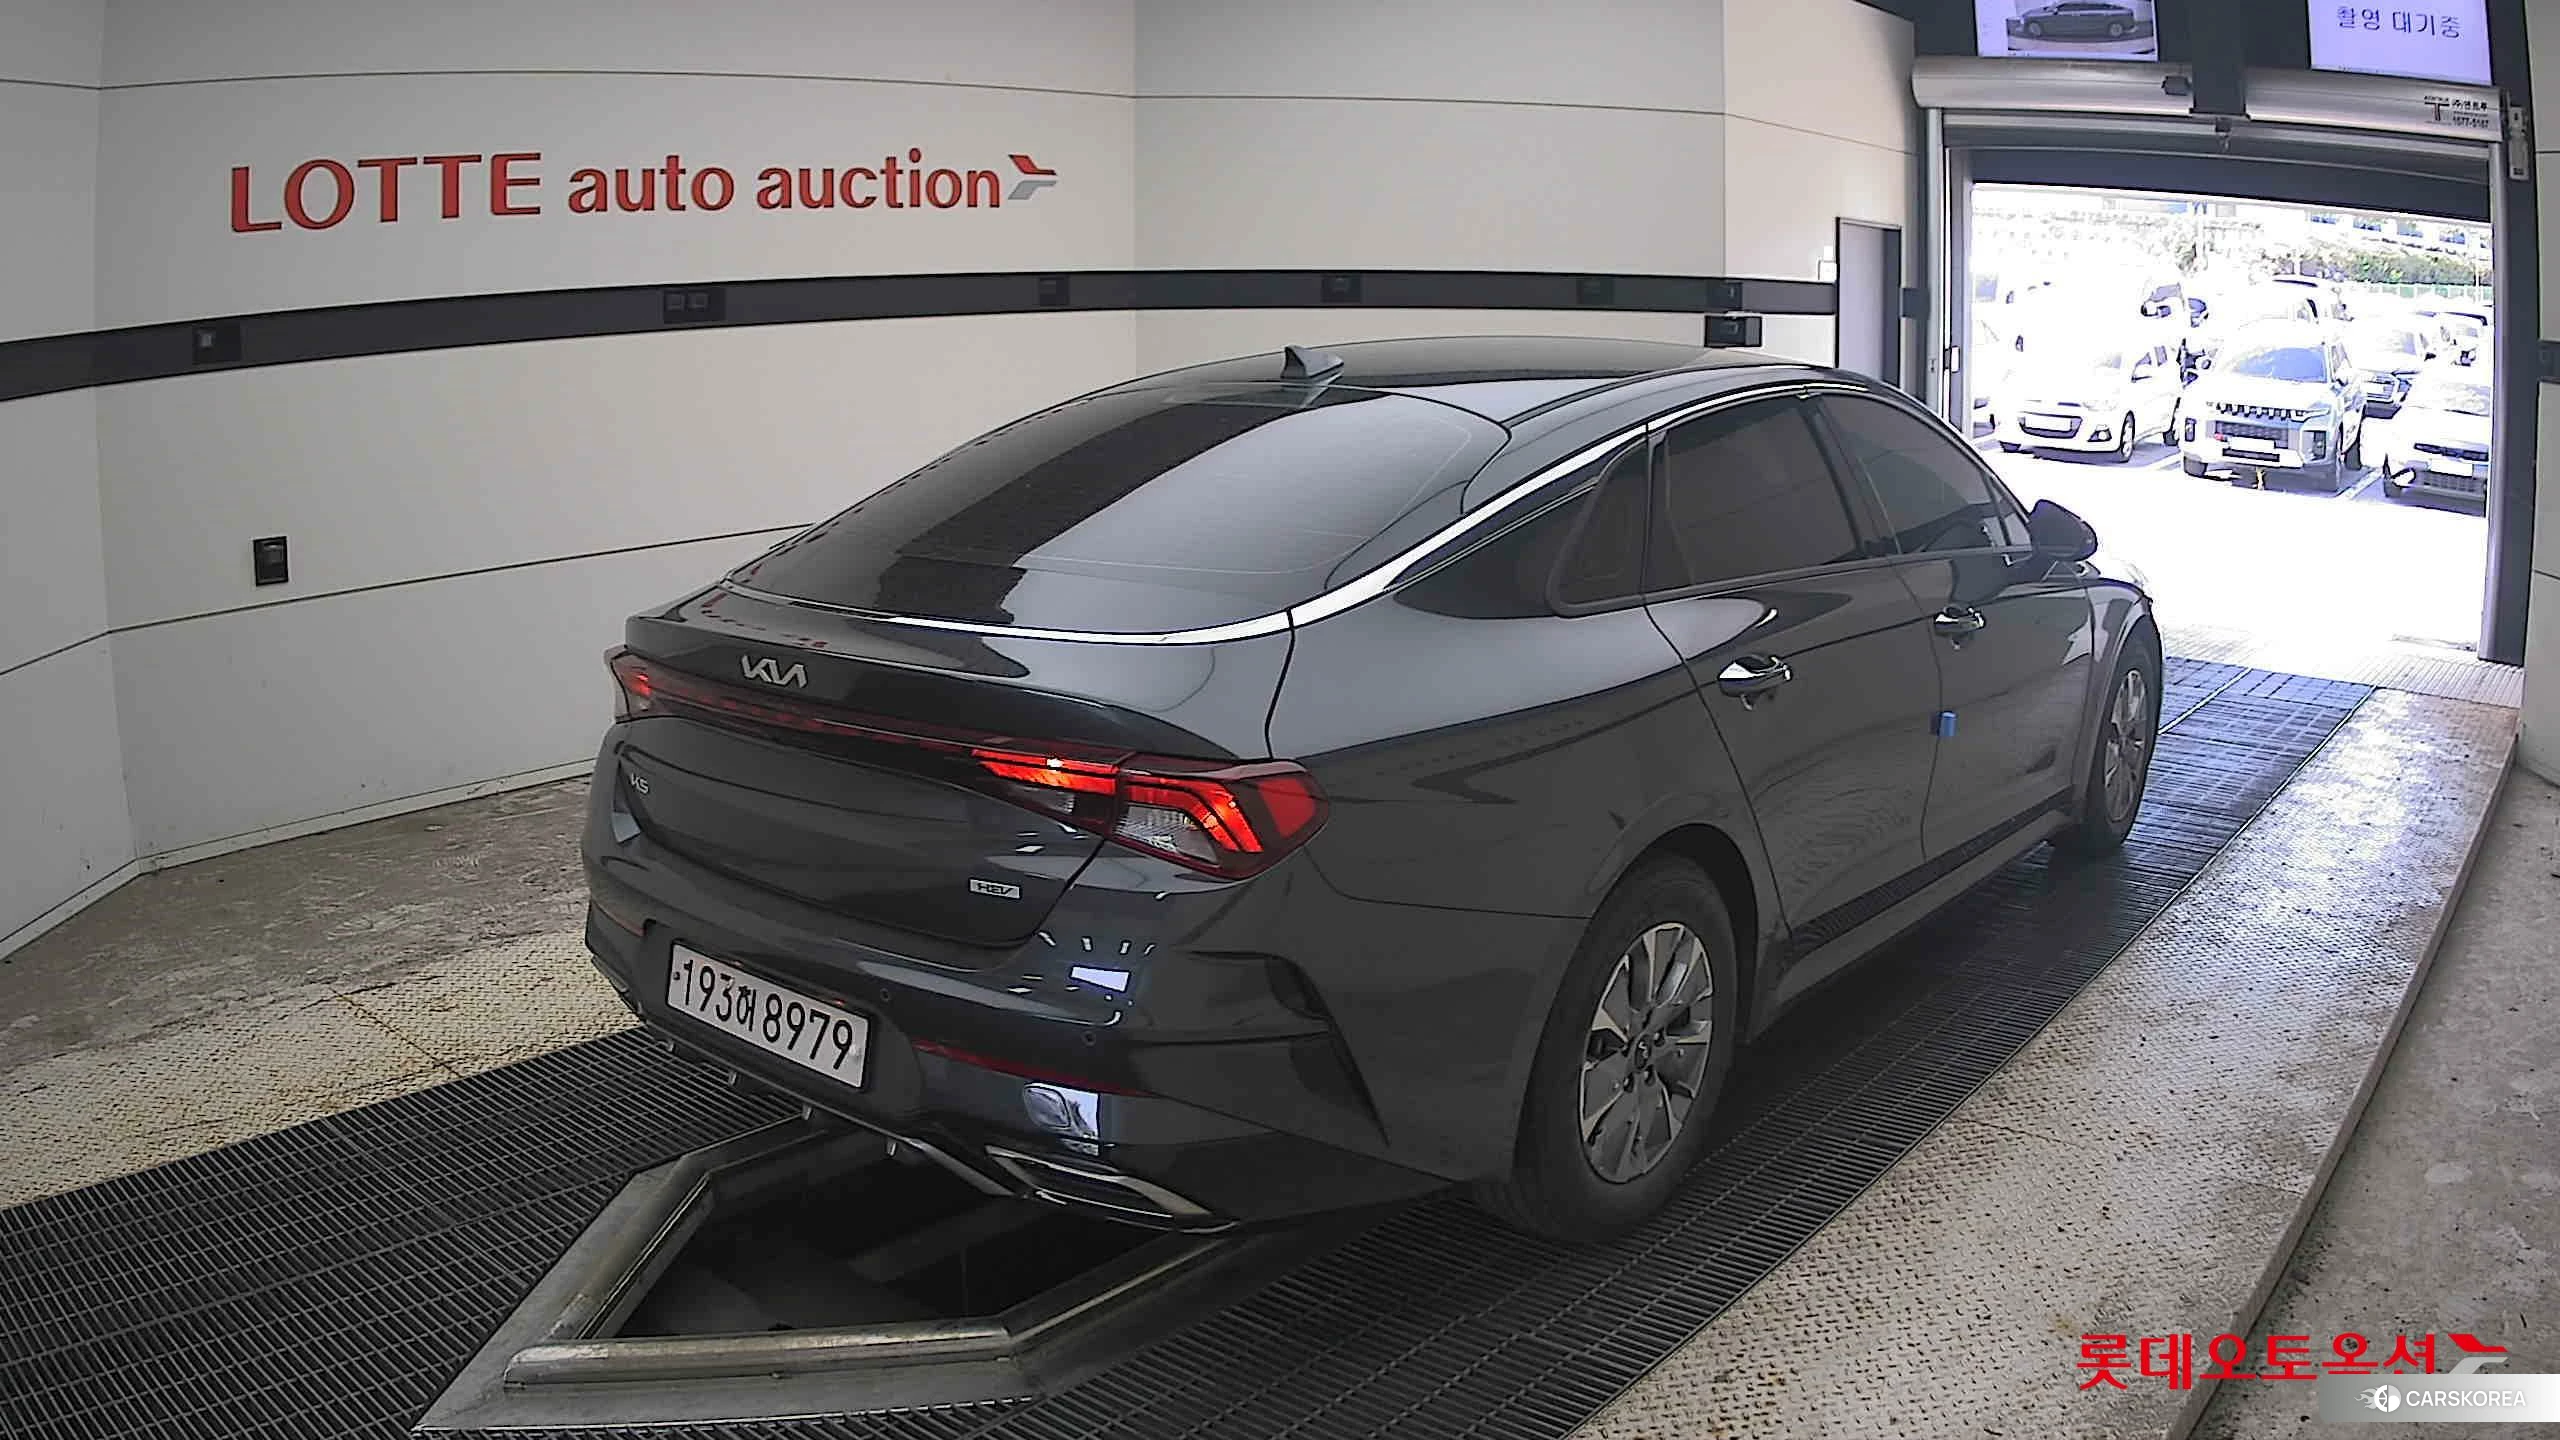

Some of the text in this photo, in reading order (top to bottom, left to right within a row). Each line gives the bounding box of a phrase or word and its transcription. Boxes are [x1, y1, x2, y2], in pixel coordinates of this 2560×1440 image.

[2337, 6, 2461, 39] 촬영 대기중
[231, 147, 1003, 233] LOTTE auto auction
[740, 654, 808, 689] KIA
[630, 772, 650, 795] K5
[977, 882, 1015, 895] HEV
[683, 959, 854, 1070] 193허8979
